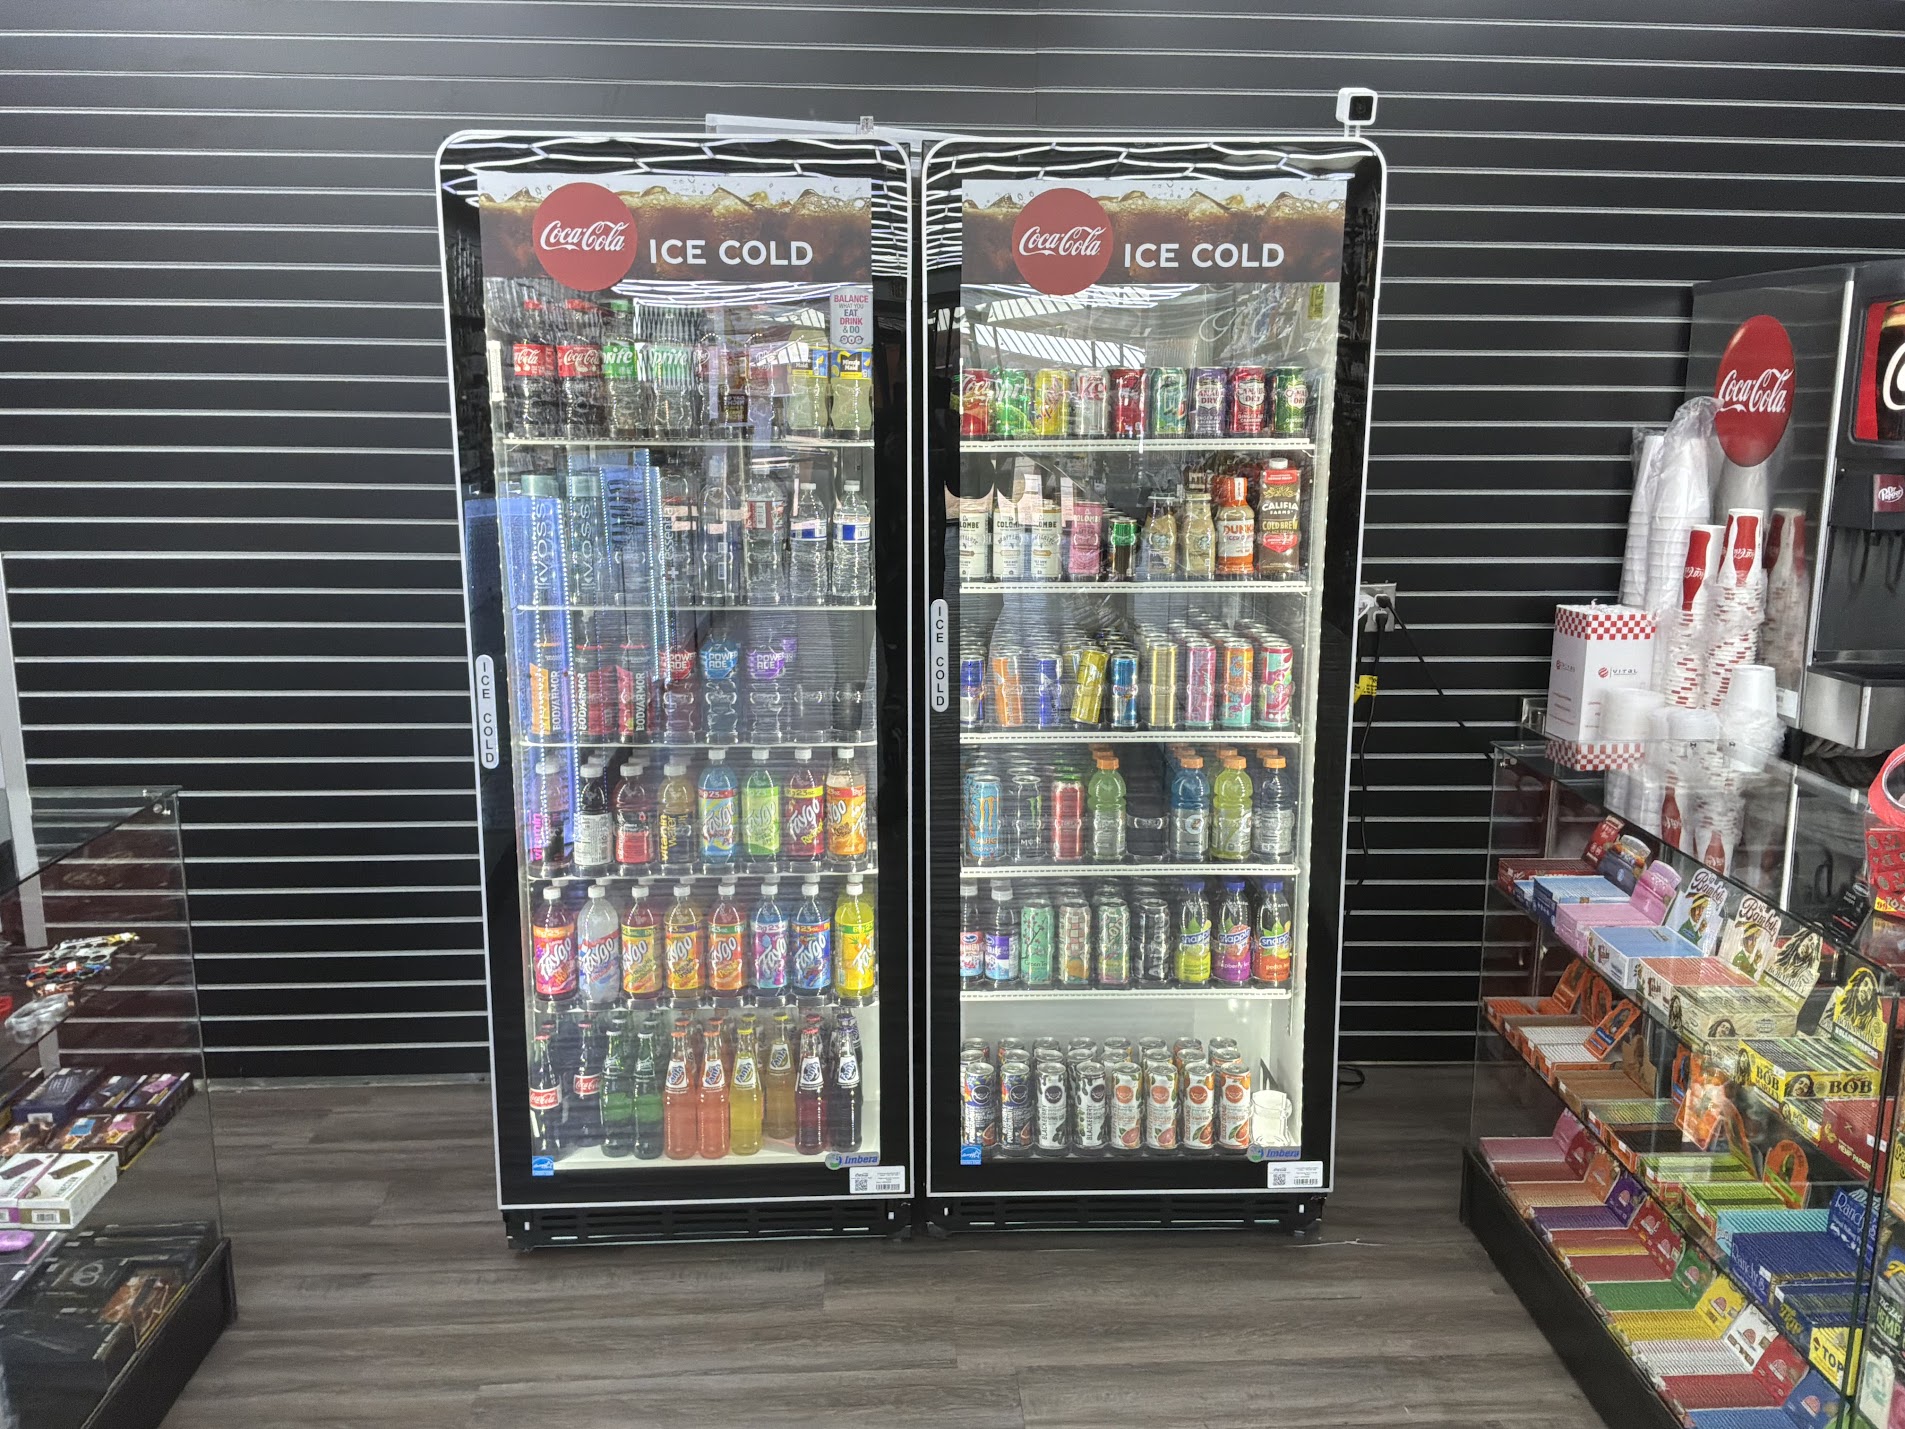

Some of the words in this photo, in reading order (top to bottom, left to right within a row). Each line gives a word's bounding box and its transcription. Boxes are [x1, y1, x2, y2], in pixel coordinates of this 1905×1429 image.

[540, 220, 631, 251] Coca-Cola
[1018, 225, 1106, 256] Coca-Cola
[650, 239, 706, 264] ICE
[718, 240, 813, 266] COLD
[1124, 243, 1179, 268] ICE
[1191, 243, 1285, 268] COLD
[834, 295, 869, 303] BALANCE
[844, 309, 858, 317] EAT
[840, 317, 863, 325] DRINK
[1718, 368, 1794, 413] Coca-Cola
[1261, 501, 1299, 511] CALIFIA
[537, 502, 549, 578] VOSS
[581, 503, 593, 577] VOSS
[1262, 521, 1280, 531] COLD
[1280, 520, 1299, 530] BREW
[936, 606, 944, 643] ICE
[481, 661, 491, 699] ICE
[936, 656, 945, 706] COLD
[550, 670, 561, 731] BODYARMOR
[635, 672, 646, 731] BODYARMOR
[483, 712, 495, 763] COLD
[787, 798, 820, 841] Faygo
[660, 812, 669, 862] vitamin
[537, 937, 572, 981] Faygo
[794, 934, 827, 976] Faygo
[770, 1048, 787, 1068] Fanta
[704, 1063, 721, 1086] Fanta
[734, 1062, 753, 1084] Fanta
[1756, 1065, 1779, 1091] BOB
[1829, 1080, 1873, 1094] BOB
[845, 1155, 879, 1165] Imbera
[1837, 1143, 1853, 1158] HEMP
[1822, 1345, 1845, 1372] TOP
